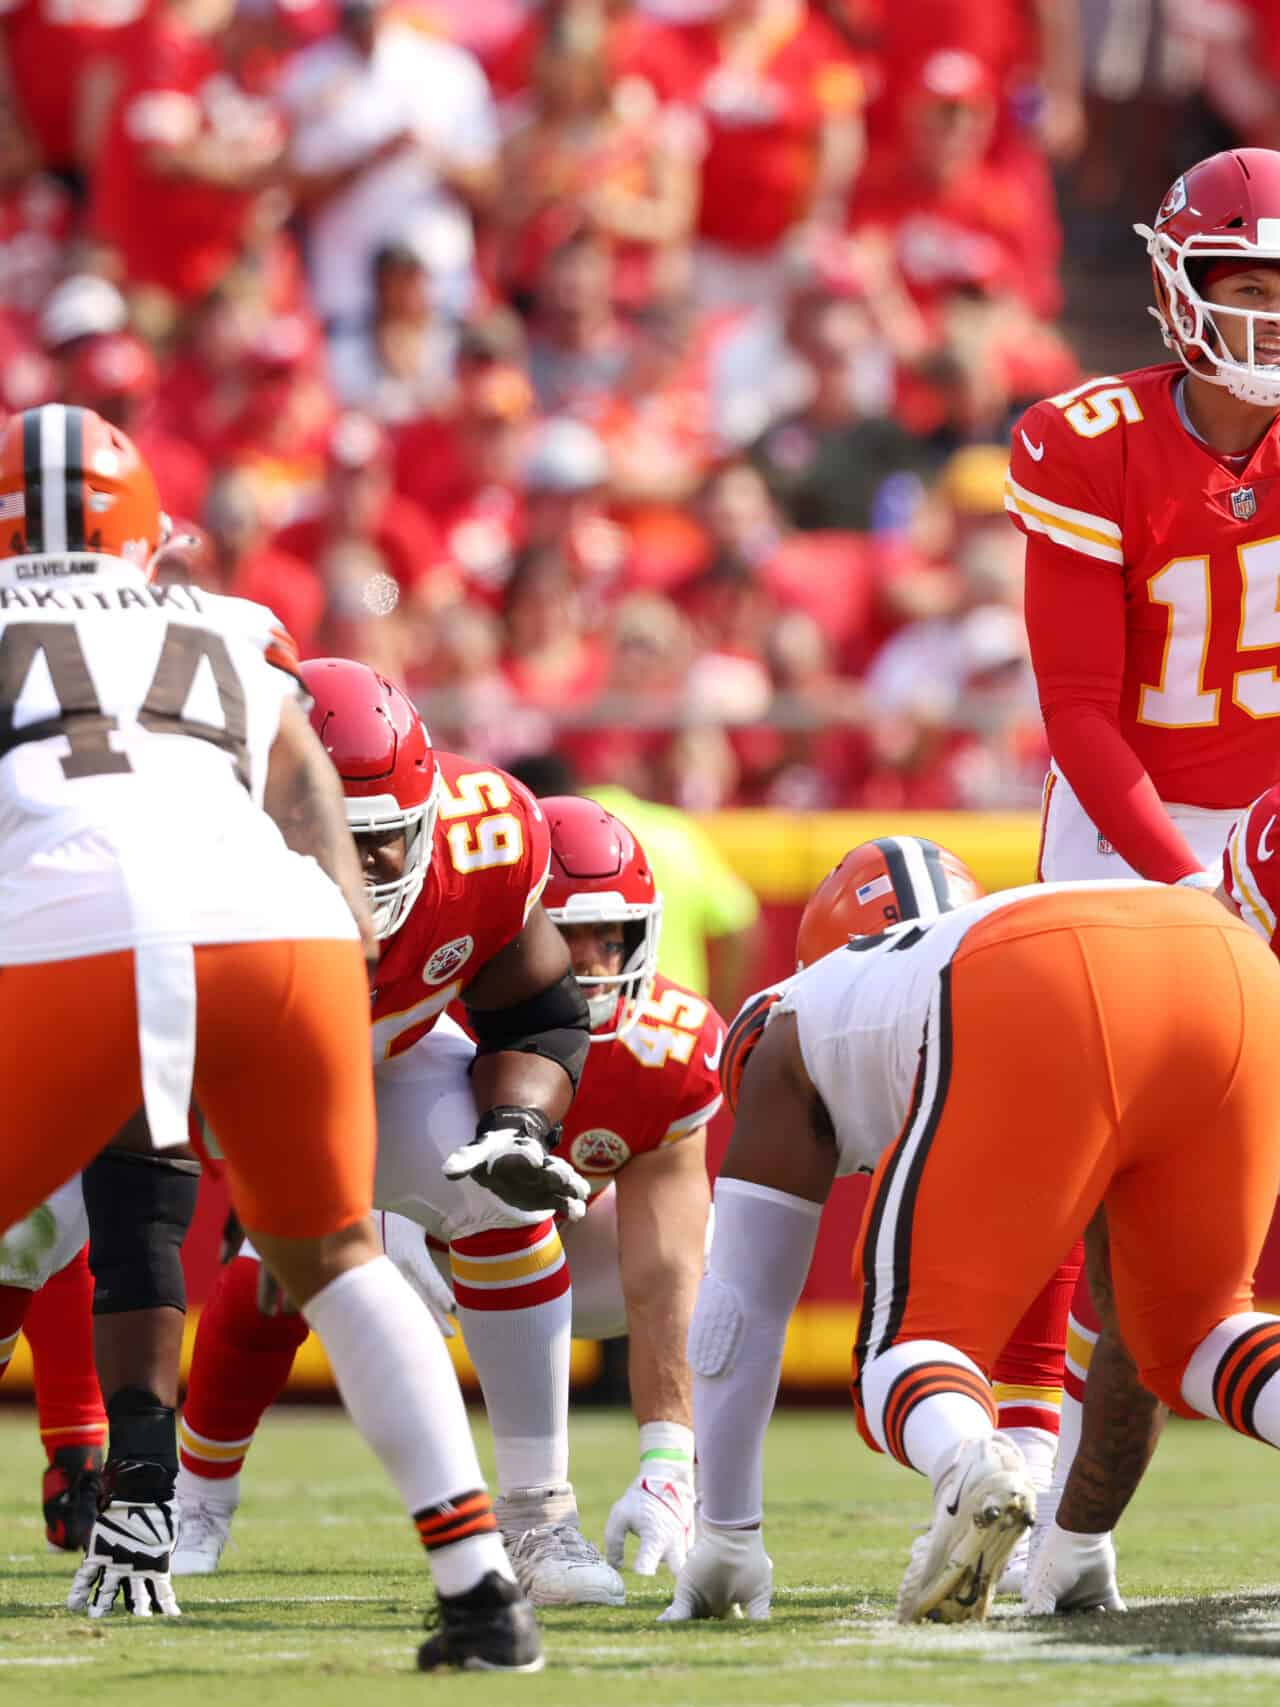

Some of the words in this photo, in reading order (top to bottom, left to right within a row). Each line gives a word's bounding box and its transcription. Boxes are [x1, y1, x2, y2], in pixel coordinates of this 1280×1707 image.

[1046, 375, 1145, 439] 15
[0, 620, 253, 792] 44
[437, 769, 525, 875] 65
[617, 980, 709, 1069] 45
